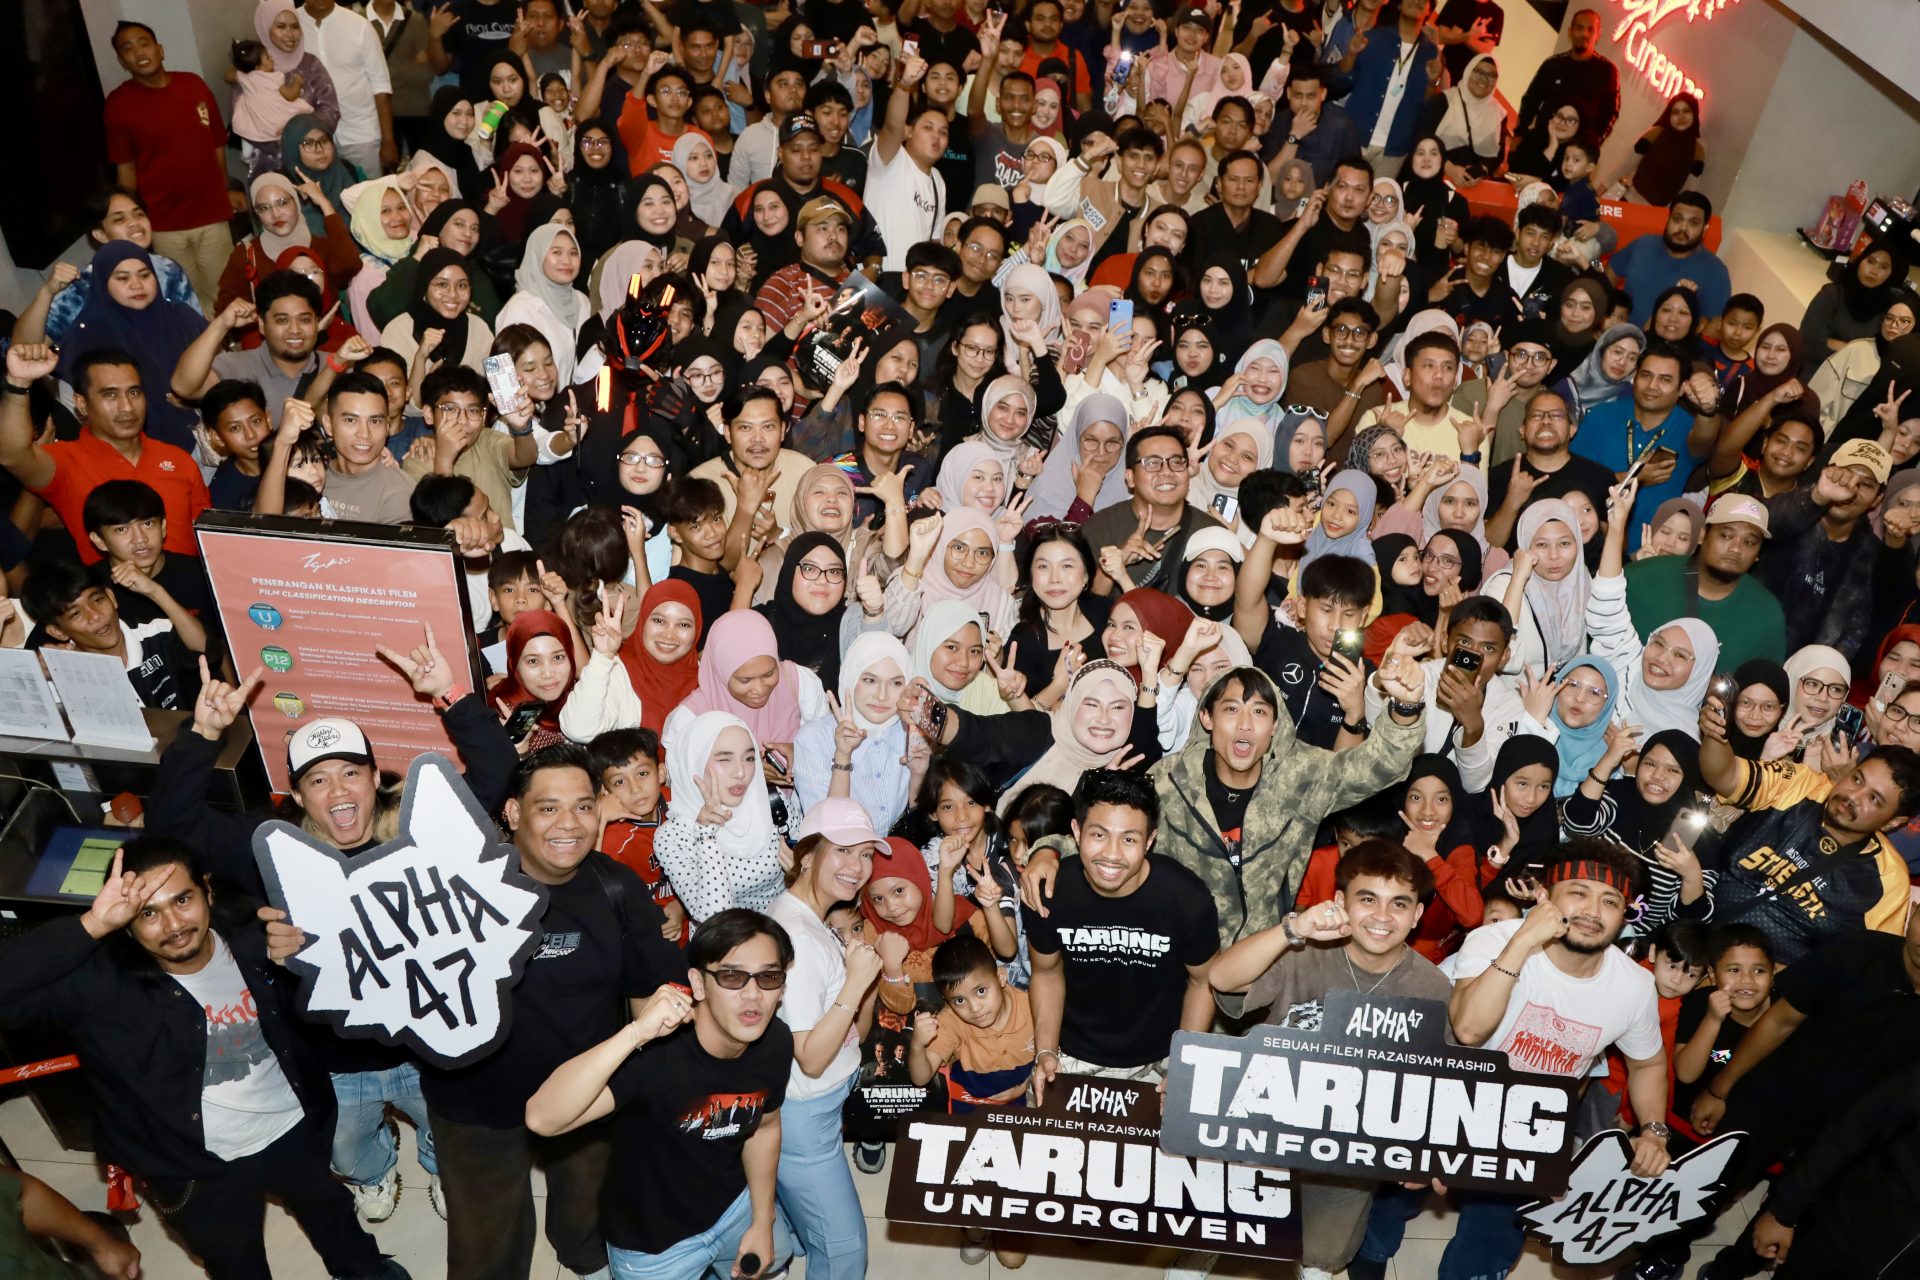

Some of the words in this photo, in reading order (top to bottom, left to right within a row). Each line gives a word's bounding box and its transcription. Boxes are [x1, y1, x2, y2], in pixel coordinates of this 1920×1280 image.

[252, 577, 323, 591] PENERANGAN
[326, 583, 387, 597] KLASIFIKASI
[389, 589, 417, 599] FILEM
[259, 588, 280, 597] FILM
[282, 591, 354, 604] CLASSIFICATION
[355, 597, 416, 609] DESCRIPTION
[258, 611, 273, 623] U
[264, 653, 290, 666] P12
[339, 866, 510, 1001] ALPHA
[1057, 928, 1170, 953] TARUNG
[1066, 945, 1162, 958] UNFORGIVEN
[405, 947, 478, 1030] 47
[1263, 1036, 1321, 1053] SEBUAH
[1323, 1043, 1364, 1059] FILEM
[1367, 1048, 1443, 1068] RAZAISYAM
[1446, 1058, 1496, 1074] RASHID
[861, 1087, 927, 1099] TARUNG
[1180, 1044, 1569, 1154] TARUNG
[703, 1123, 740, 1137] TARUNG
[987, 1113, 1042, 1128] SEBUAH
[1045, 1117, 1085, 1132] FILEM
[1087, 1122, 1161, 1138] RAZAISYAM
[1198, 1123, 1536, 1182] UNFORGIVEN
[908, 1122, 1291, 1219] TARUNG
[1553, 1178, 1680, 1224] ALPHA
[923, 1190, 1267, 1246] UNFORGIVEN
[1571, 1216, 1640, 1255] 47
